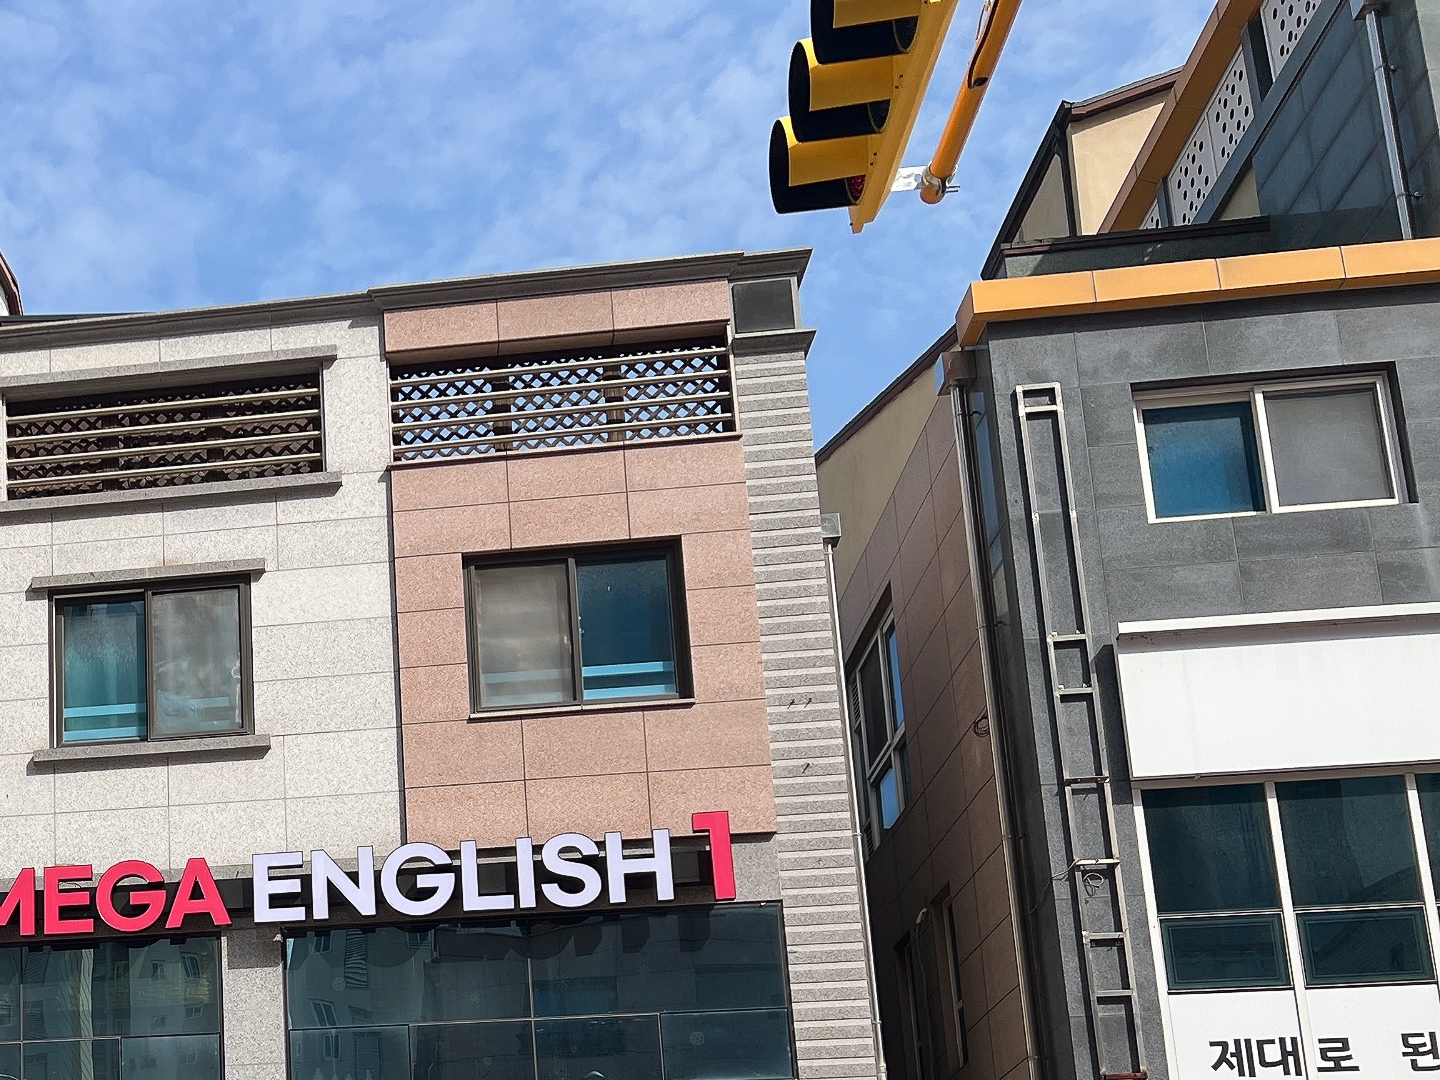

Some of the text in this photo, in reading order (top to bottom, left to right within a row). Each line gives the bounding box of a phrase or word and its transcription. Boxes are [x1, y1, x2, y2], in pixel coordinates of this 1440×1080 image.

[251, 828, 675, 924] ENGLISH
[691, 810, 736, 900] 1
[1209, 1036, 1360, 1078] 제대로
